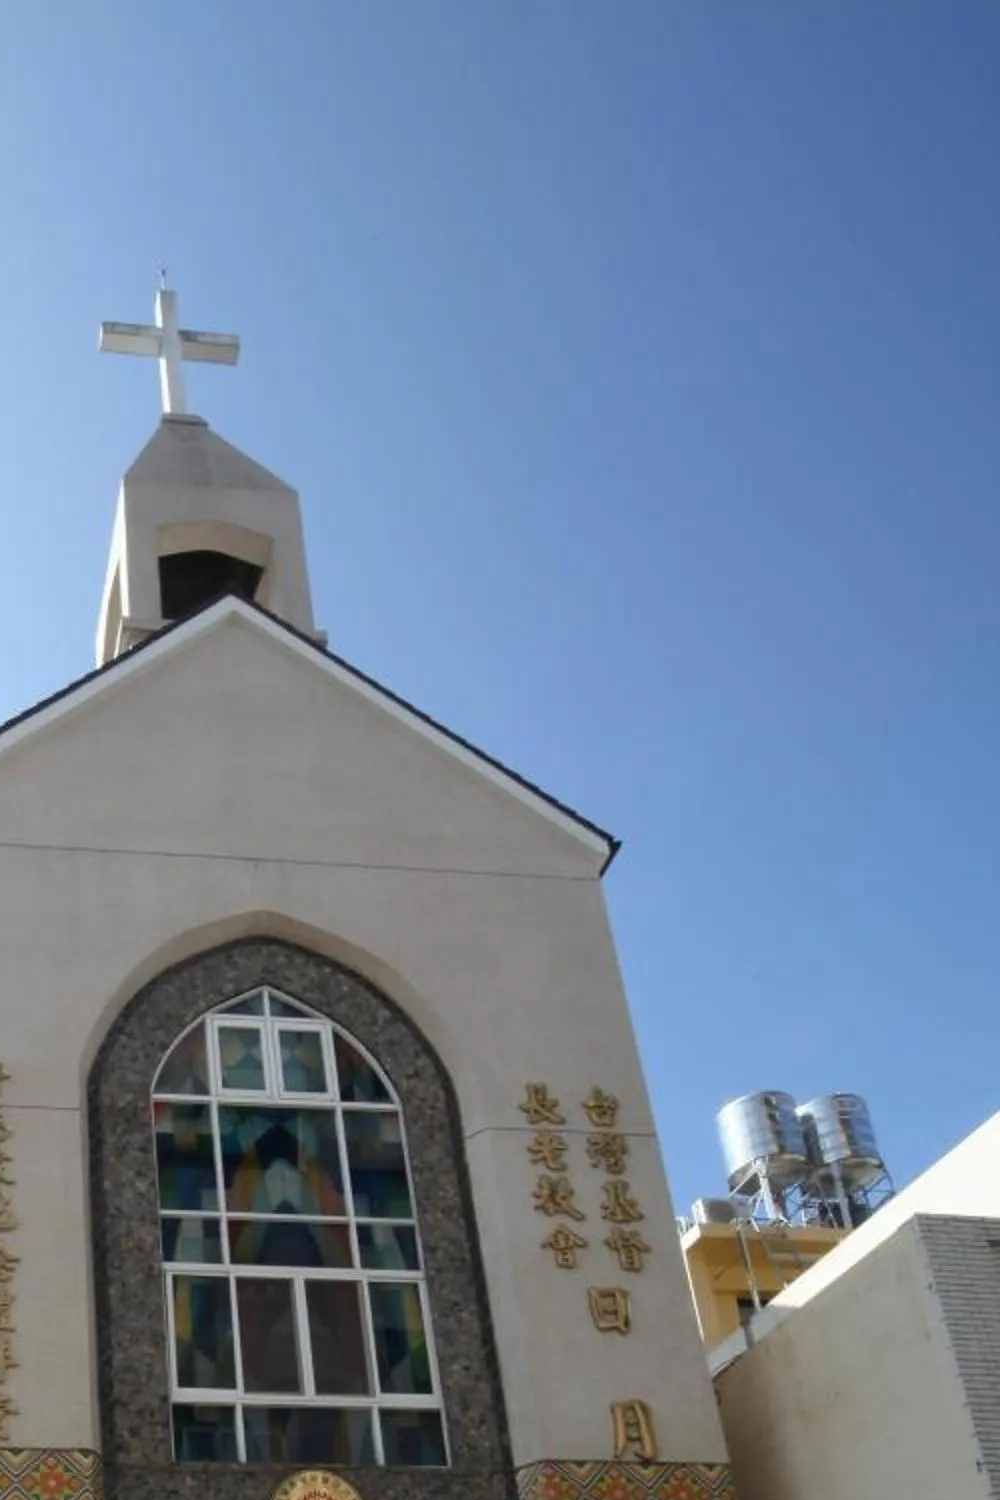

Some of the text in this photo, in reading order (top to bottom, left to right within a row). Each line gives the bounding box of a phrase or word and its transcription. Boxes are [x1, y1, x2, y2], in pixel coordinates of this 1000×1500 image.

[518, 1082, 589, 1270] 長老教會
[580, 1085, 652, 1272] 台灣基督
